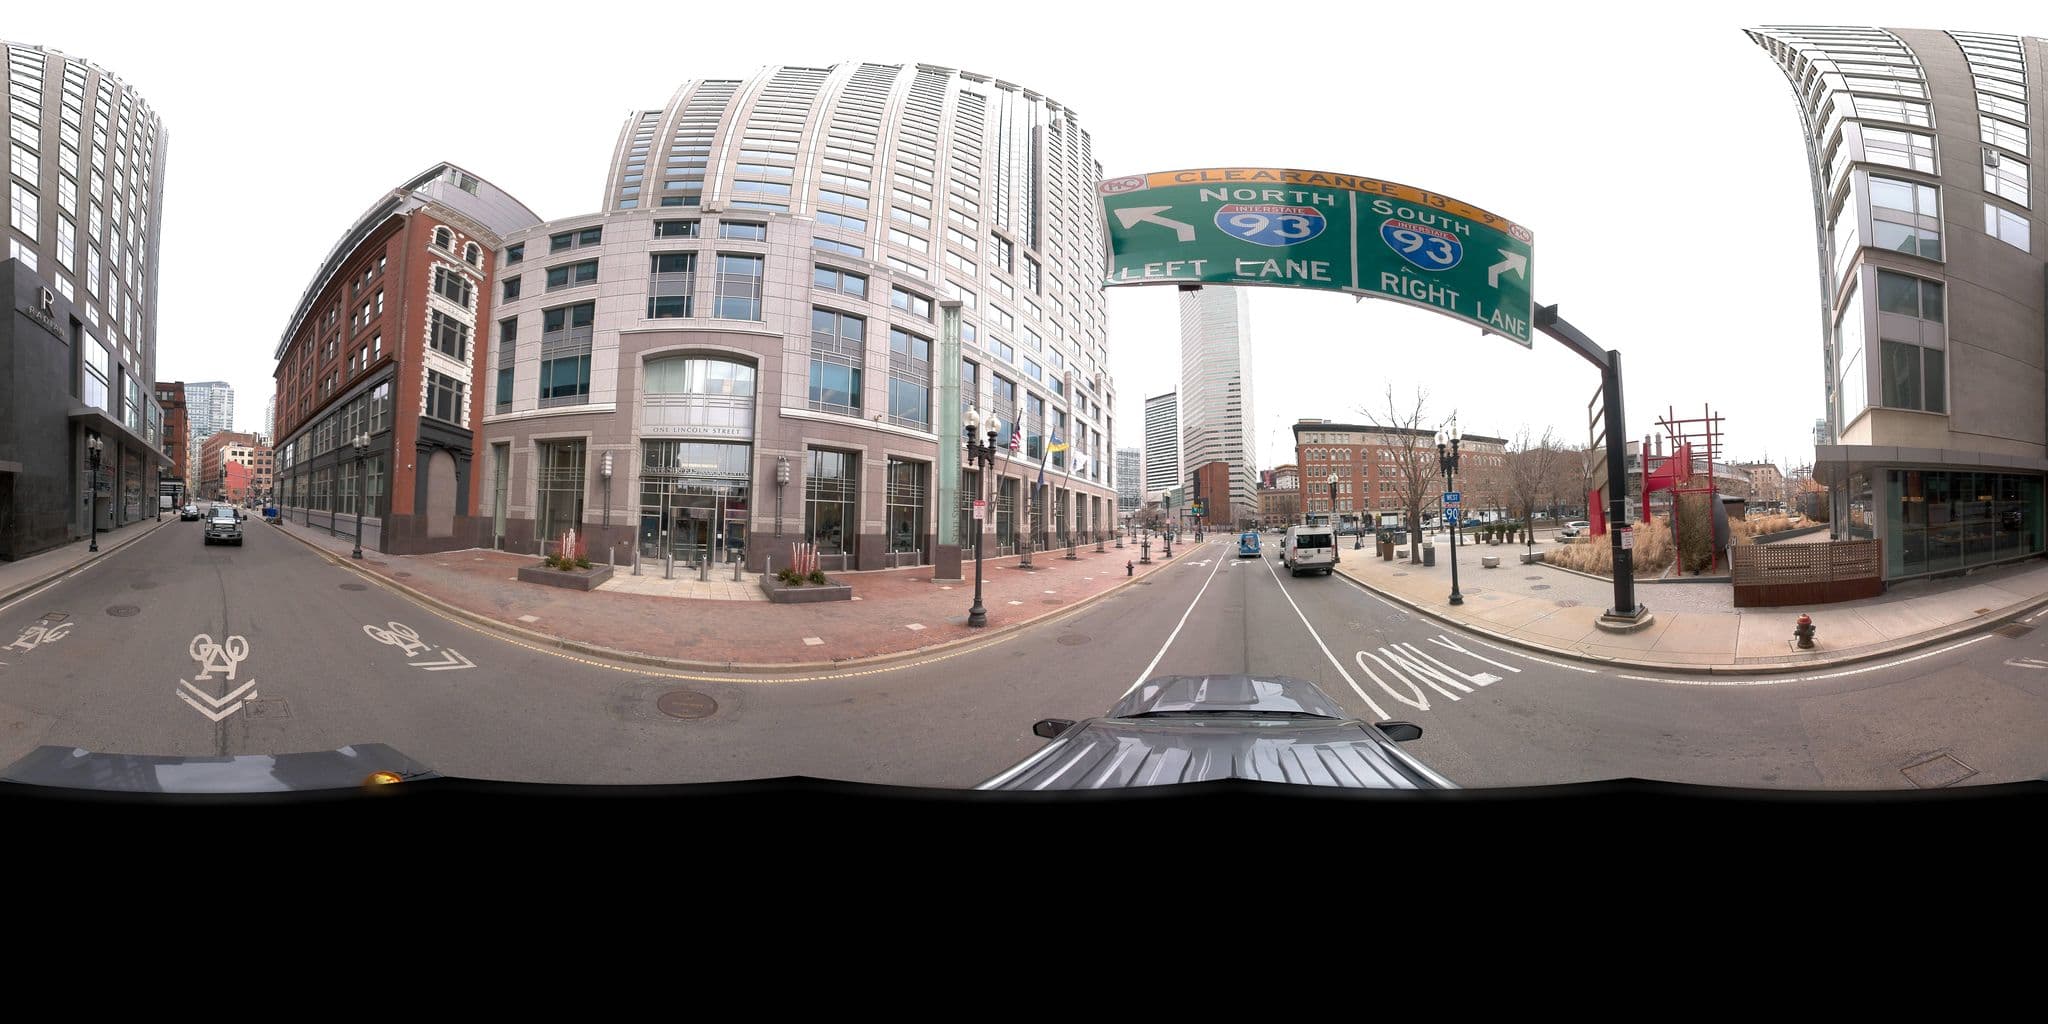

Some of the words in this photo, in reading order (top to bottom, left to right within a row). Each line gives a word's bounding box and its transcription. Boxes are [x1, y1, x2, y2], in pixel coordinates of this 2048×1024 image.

[1174, 170, 1399, 196] CLEARANCE
[1200, 187, 1335, 207] NORTH
[1235, 205, 1305, 215] INTERSTATE
[1230, 213, 1311, 239] 93
[1371, 199, 1470, 236] SOUTH
[1398, 220, 1448, 239] INTERSTATE
[1393, 230, 1454, 265] 93
[1121, 259, 1208, 280] LEFT
[1235, 257, 1332, 282] LANE
[1381, 271, 1460, 310] RIGHT
[1476, 301, 1528, 339] LANE
[1446, 508, 1458, 520] 90
[1356, 634, 1522, 711] ONLY
